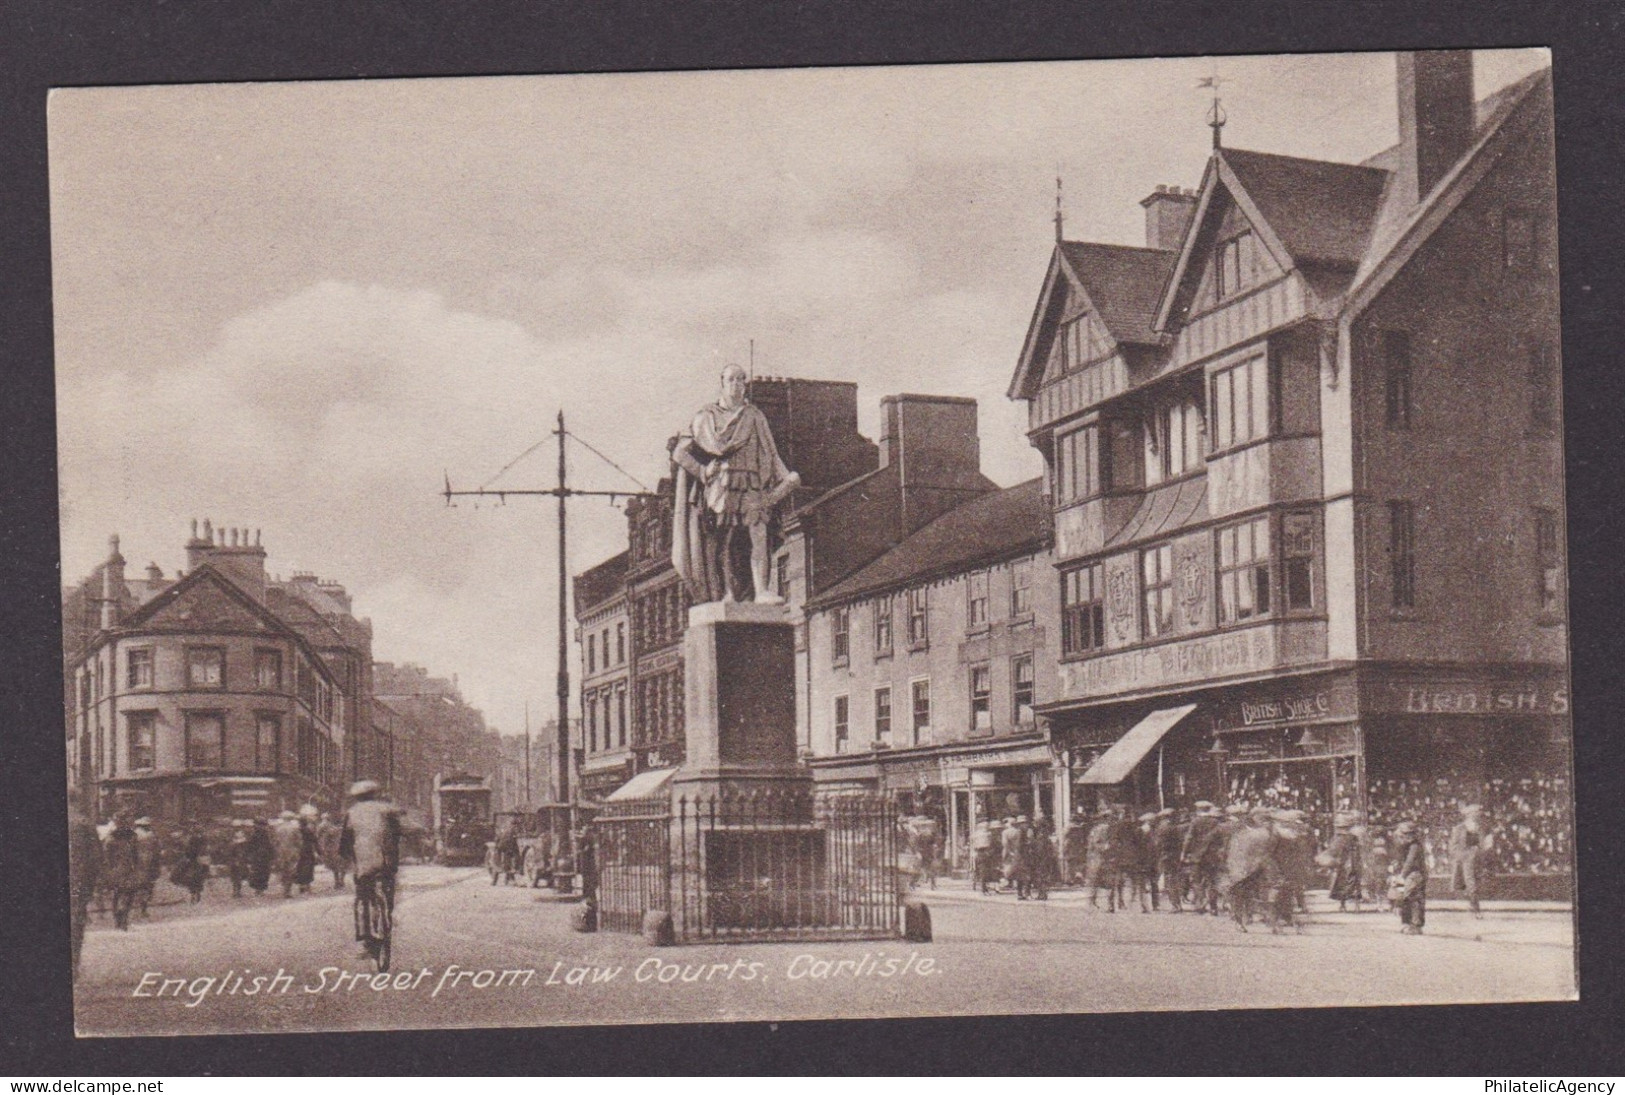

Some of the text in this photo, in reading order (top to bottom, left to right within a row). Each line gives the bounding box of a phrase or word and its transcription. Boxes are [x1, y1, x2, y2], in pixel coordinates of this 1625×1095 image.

[131, 967, 296, 1008] English
[304, 966, 434, 994] Street
[431, 964, 536, 999] from
[545, 961, 624, 986] Law
[786, 951, 944, 979] Carlisle.
